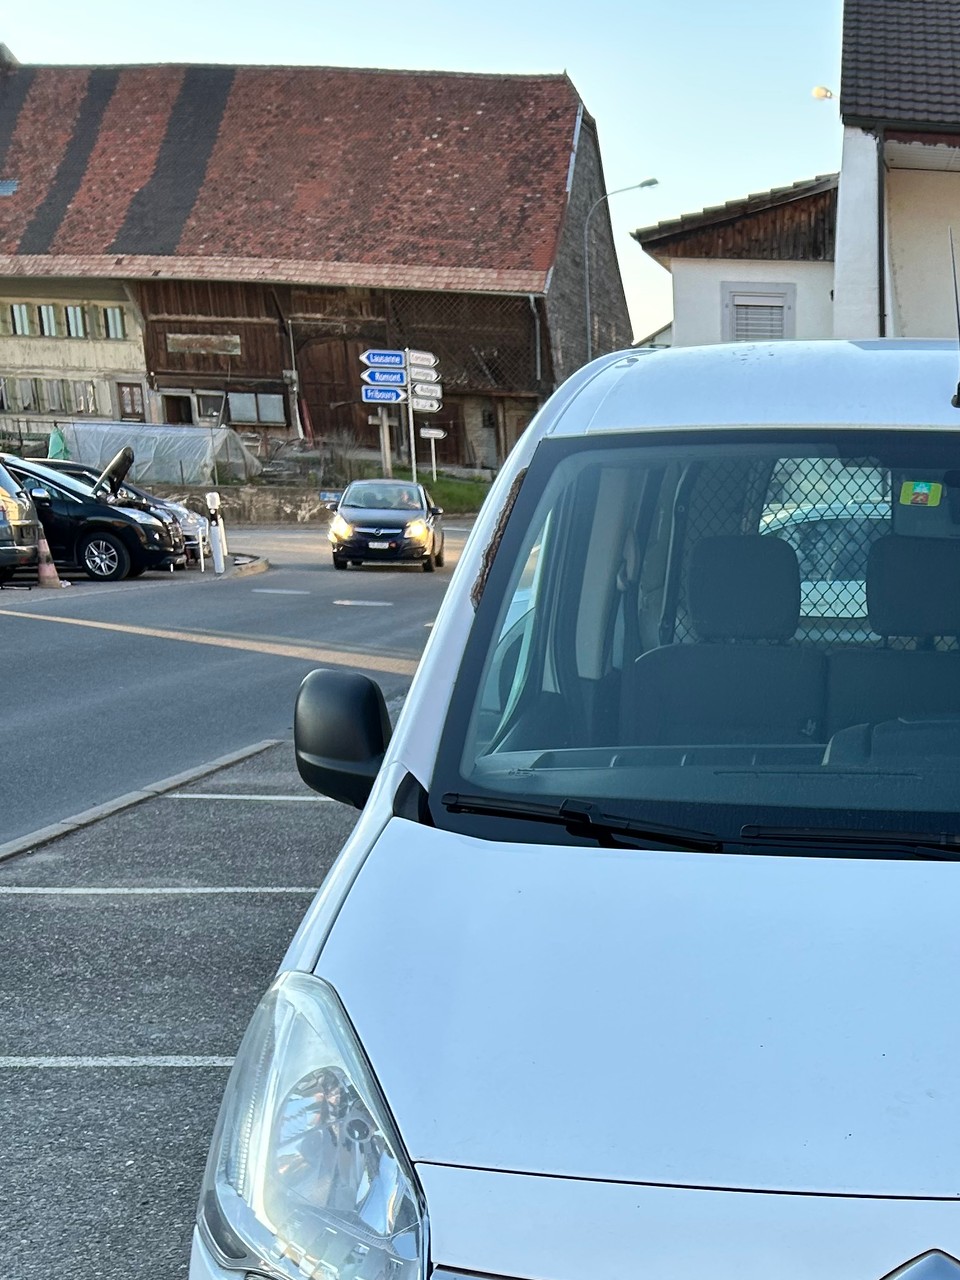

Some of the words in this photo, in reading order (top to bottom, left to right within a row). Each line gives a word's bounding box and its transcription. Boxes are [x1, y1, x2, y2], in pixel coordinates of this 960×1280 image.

[370, 353, 401, 364] Lausanne
[375, 372, 402, 382] Romont
[367, 389, 397, 401] Fribourg
